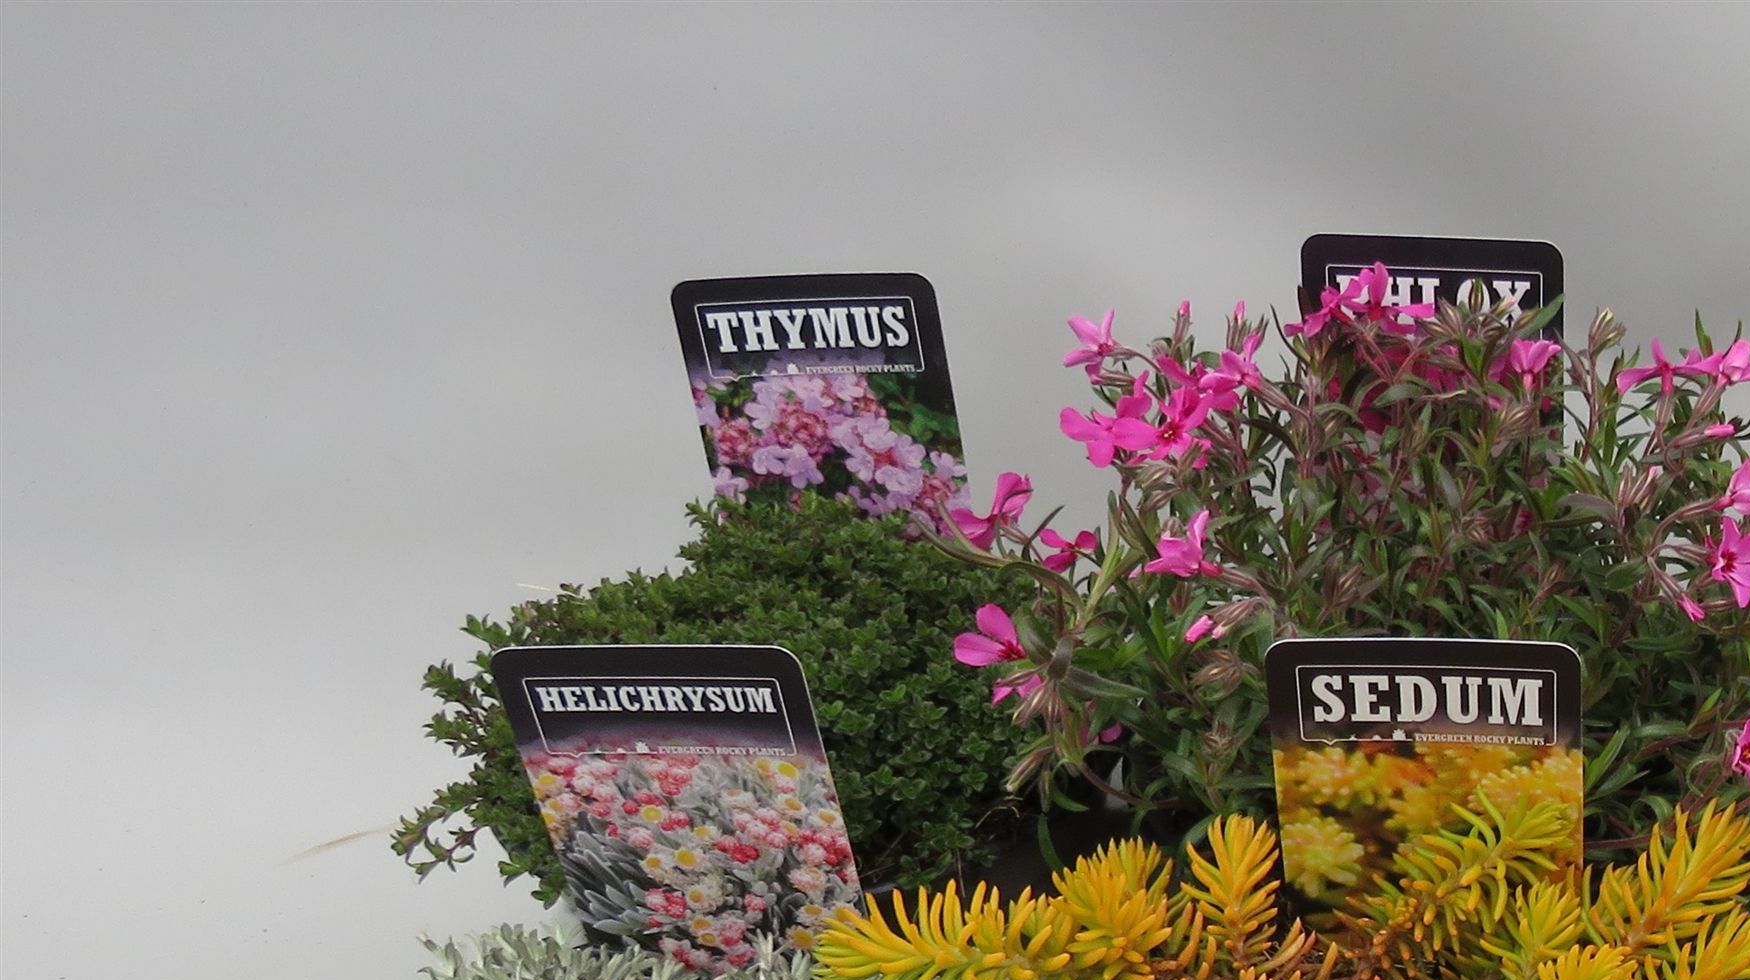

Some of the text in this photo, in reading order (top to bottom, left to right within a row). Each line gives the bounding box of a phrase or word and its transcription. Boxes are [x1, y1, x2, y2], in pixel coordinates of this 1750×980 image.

[706, 306, 910, 353] THYMUS
[535, 686, 777, 714] HELICHRYSUM
[1311, 674, 1543, 727] SEDUM
[657, 745, 786, 757] EVERGREEN ROCKY PLANTS
[1415, 732, 1546, 746] EVERGREEN ROCKY PLANTS
